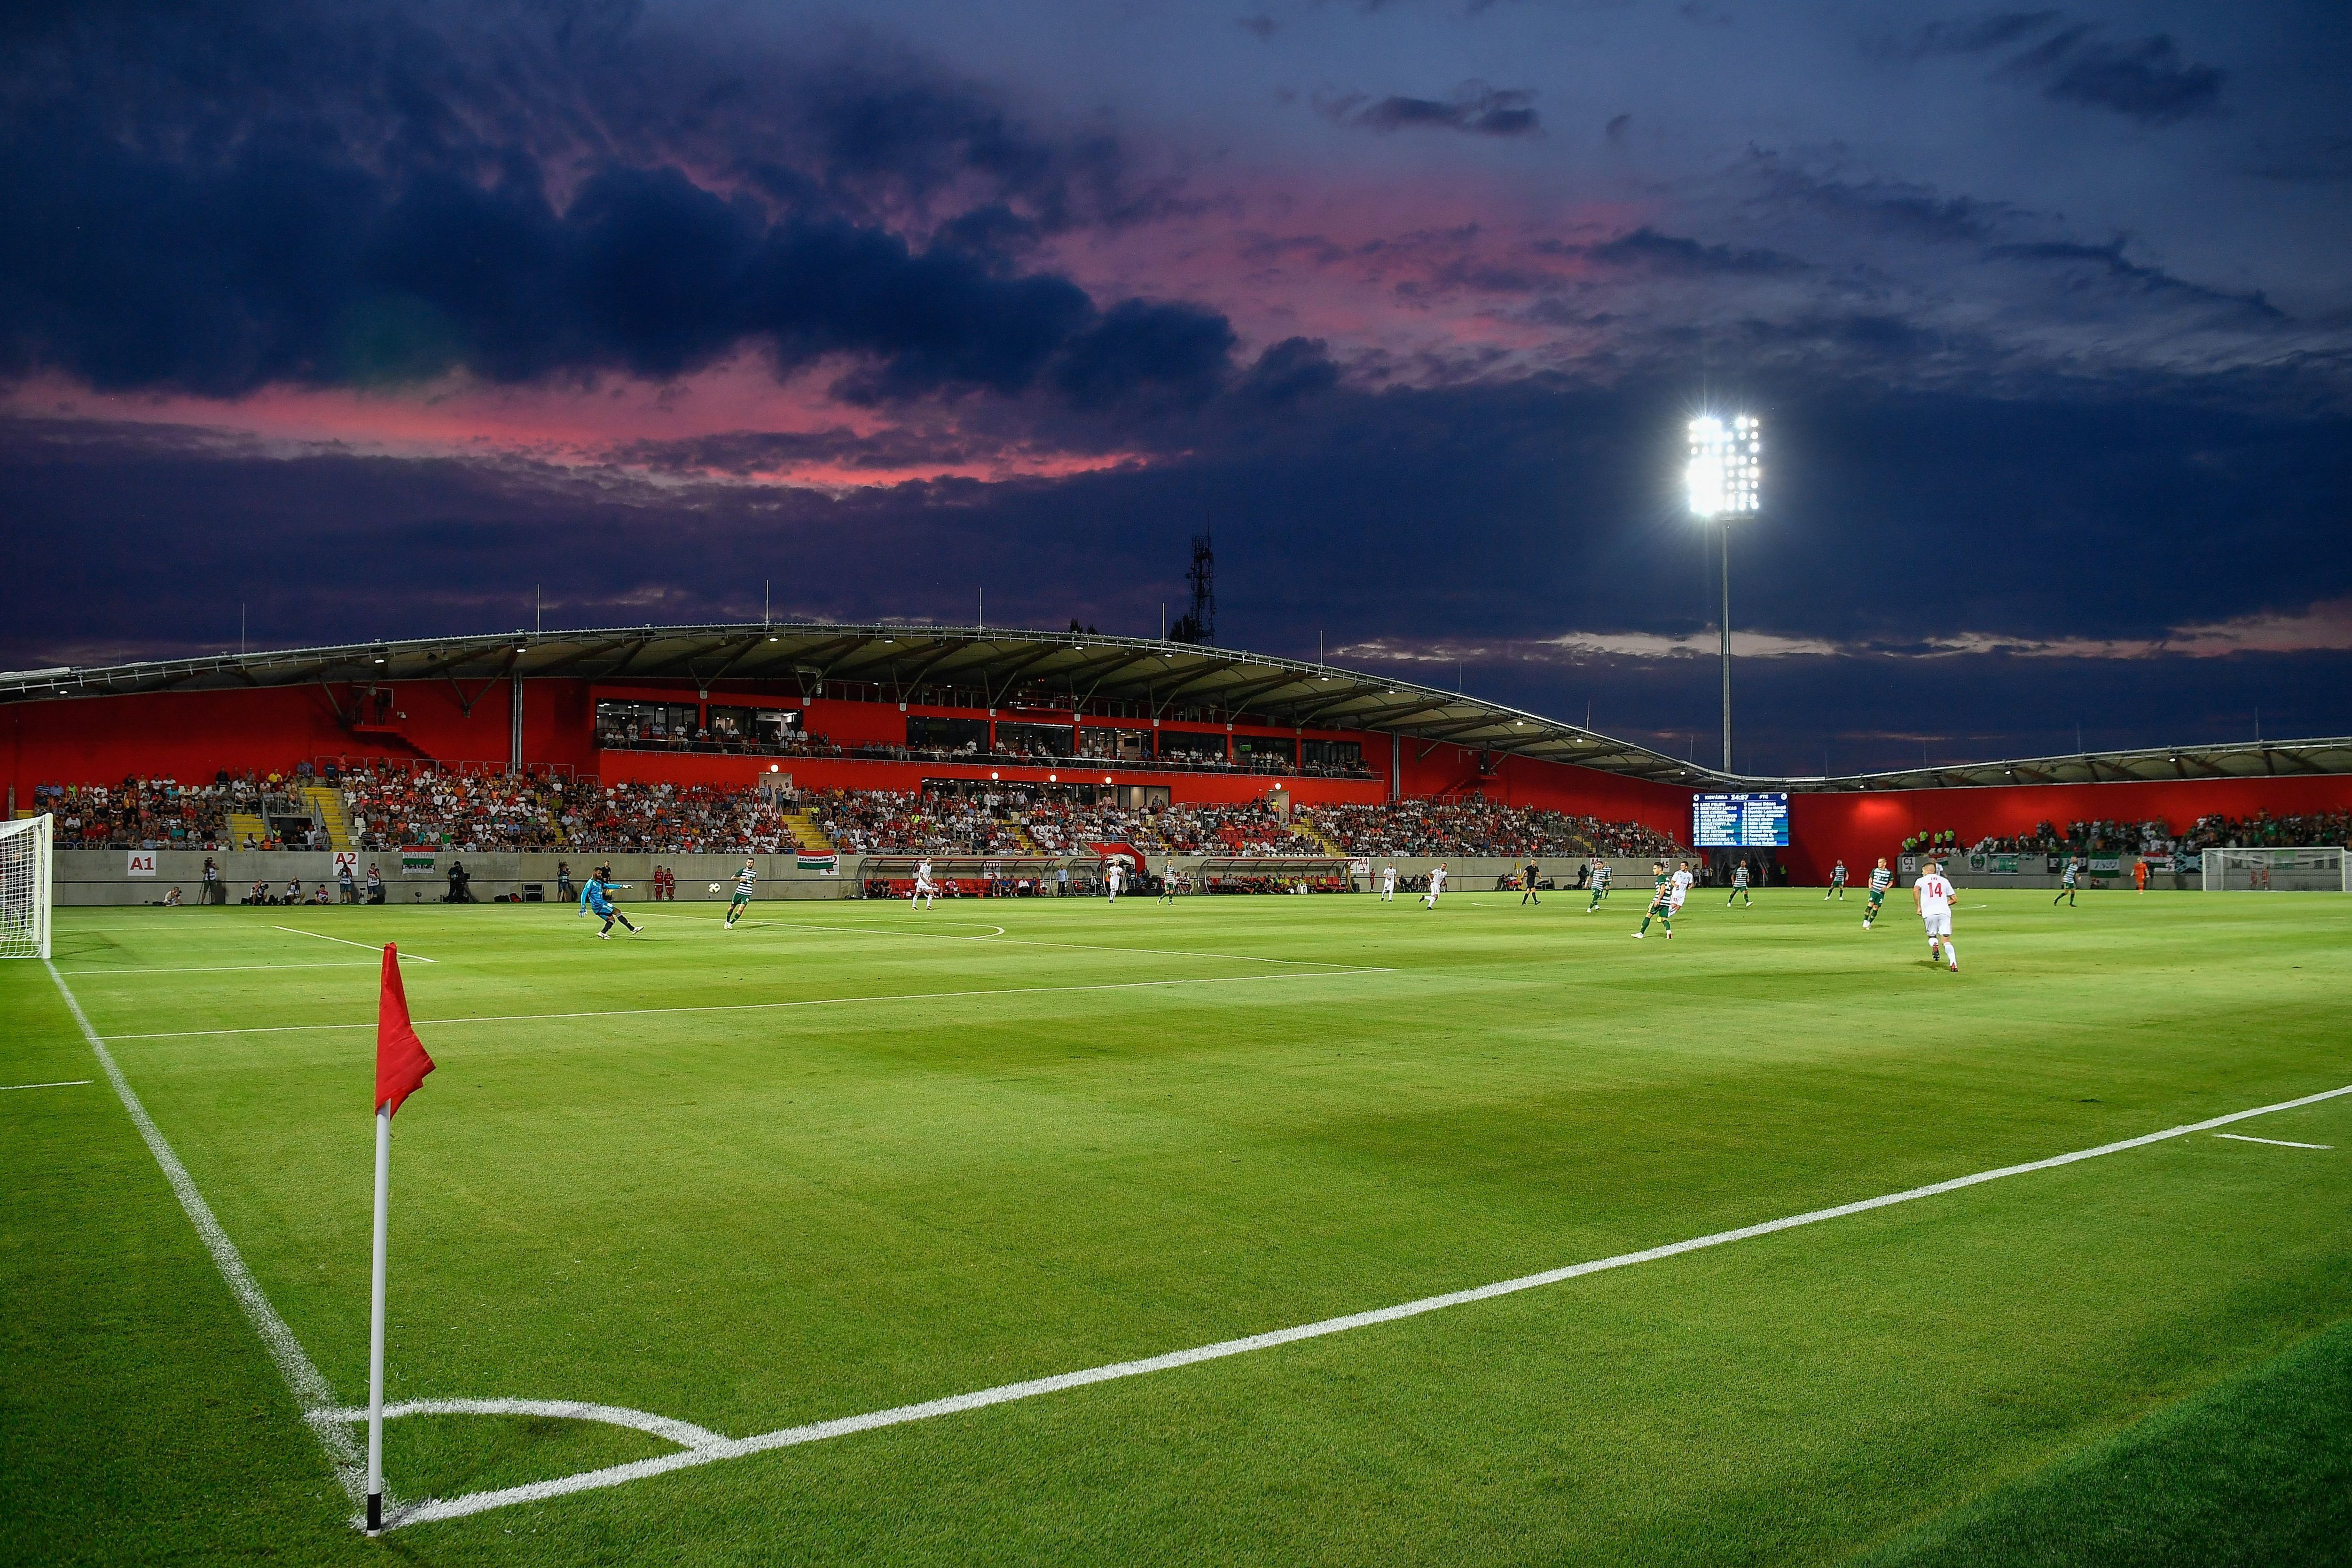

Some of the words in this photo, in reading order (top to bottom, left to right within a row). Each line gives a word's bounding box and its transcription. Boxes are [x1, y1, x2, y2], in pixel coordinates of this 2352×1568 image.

[130, 857, 154, 870] A1
[335, 853, 356, 864] A2
[1928, 882, 1943, 898] 14
